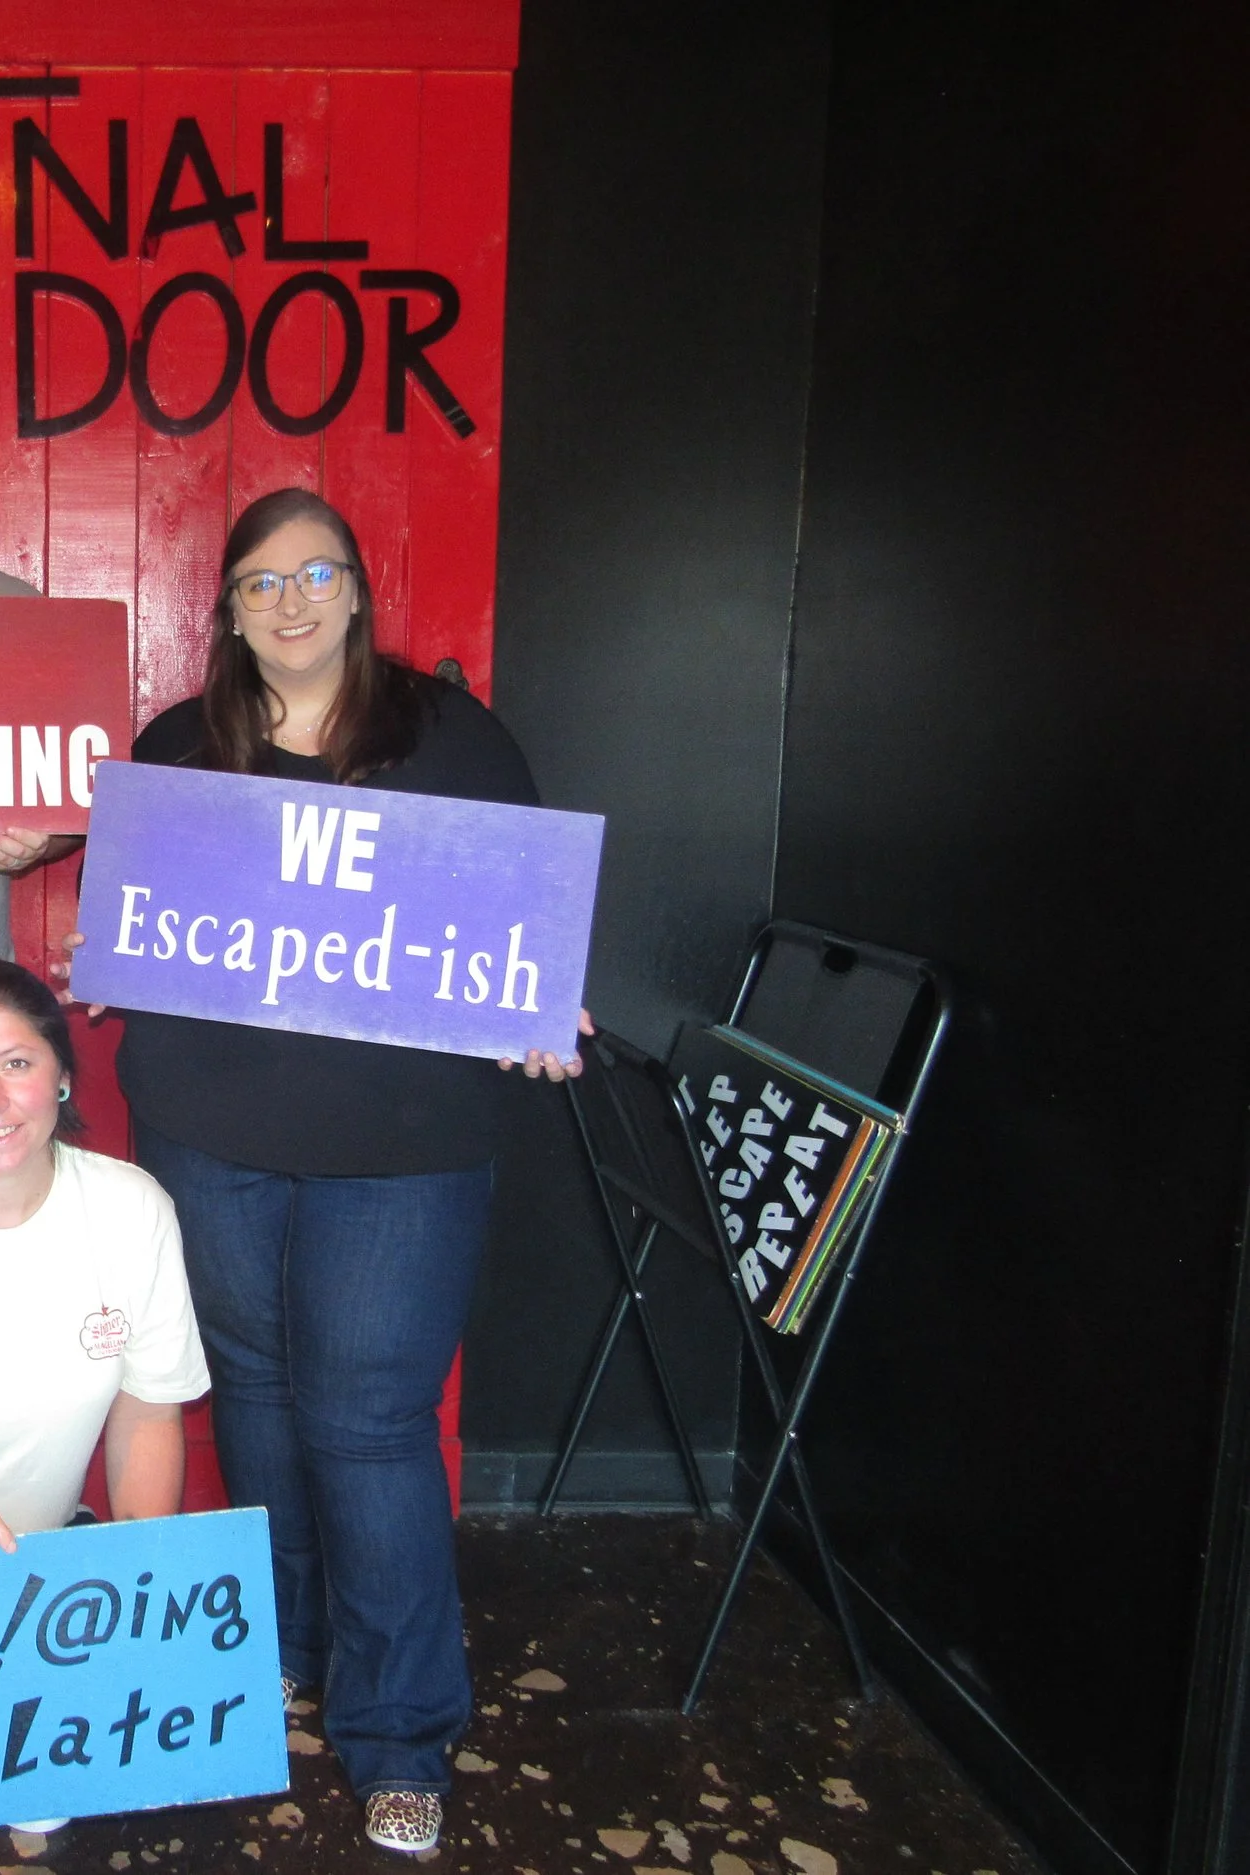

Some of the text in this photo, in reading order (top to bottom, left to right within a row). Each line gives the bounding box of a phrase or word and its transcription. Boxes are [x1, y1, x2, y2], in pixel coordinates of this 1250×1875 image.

[13, 270, 478, 442] DOOR
[280, 802, 381, 892] WE
[113, 884, 540, 1013] Escaped-ish
[737, 1102, 849, 1304] REPEAT
[1, 1687, 246, 1783] Later
